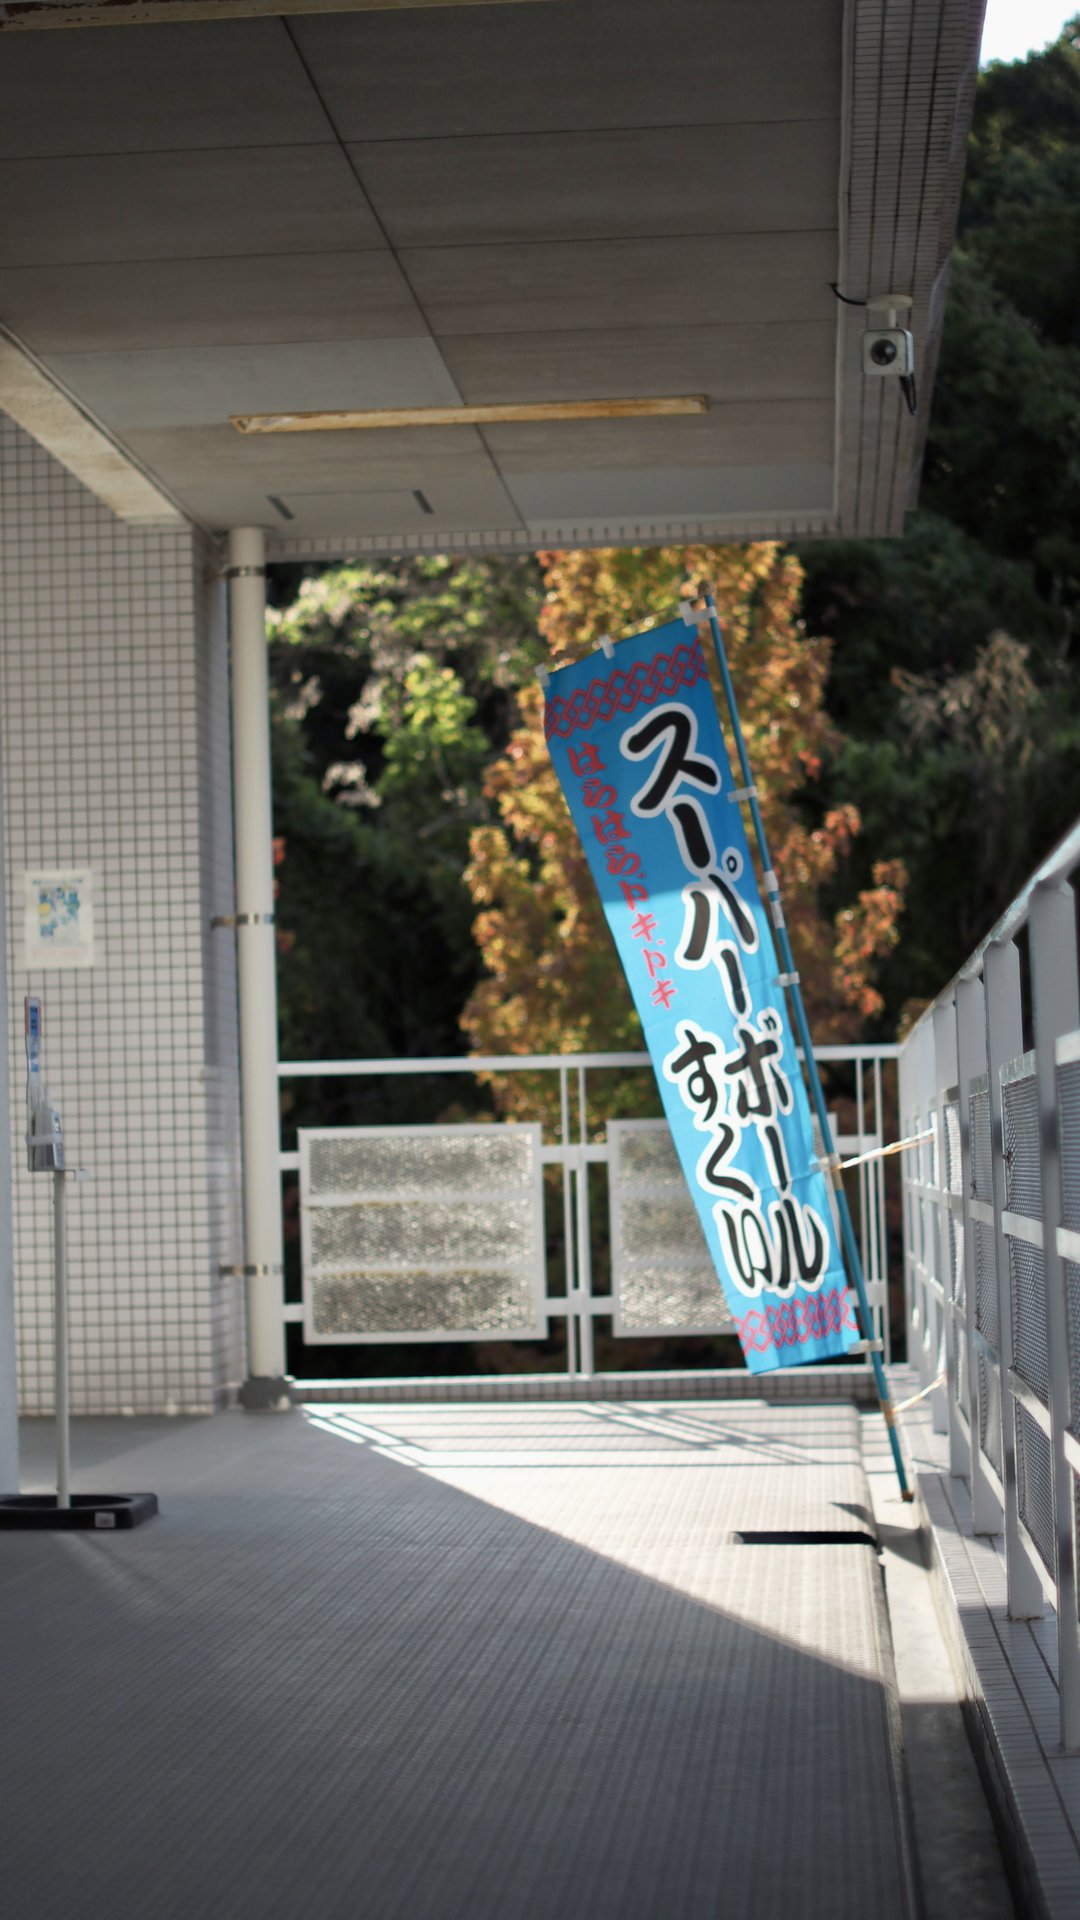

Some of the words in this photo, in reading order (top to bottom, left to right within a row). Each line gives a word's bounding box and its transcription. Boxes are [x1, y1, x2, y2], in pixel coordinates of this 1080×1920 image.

[623, 708, 826, 1292] スーパーボール
[669, 1028, 775, 1291] すくい
